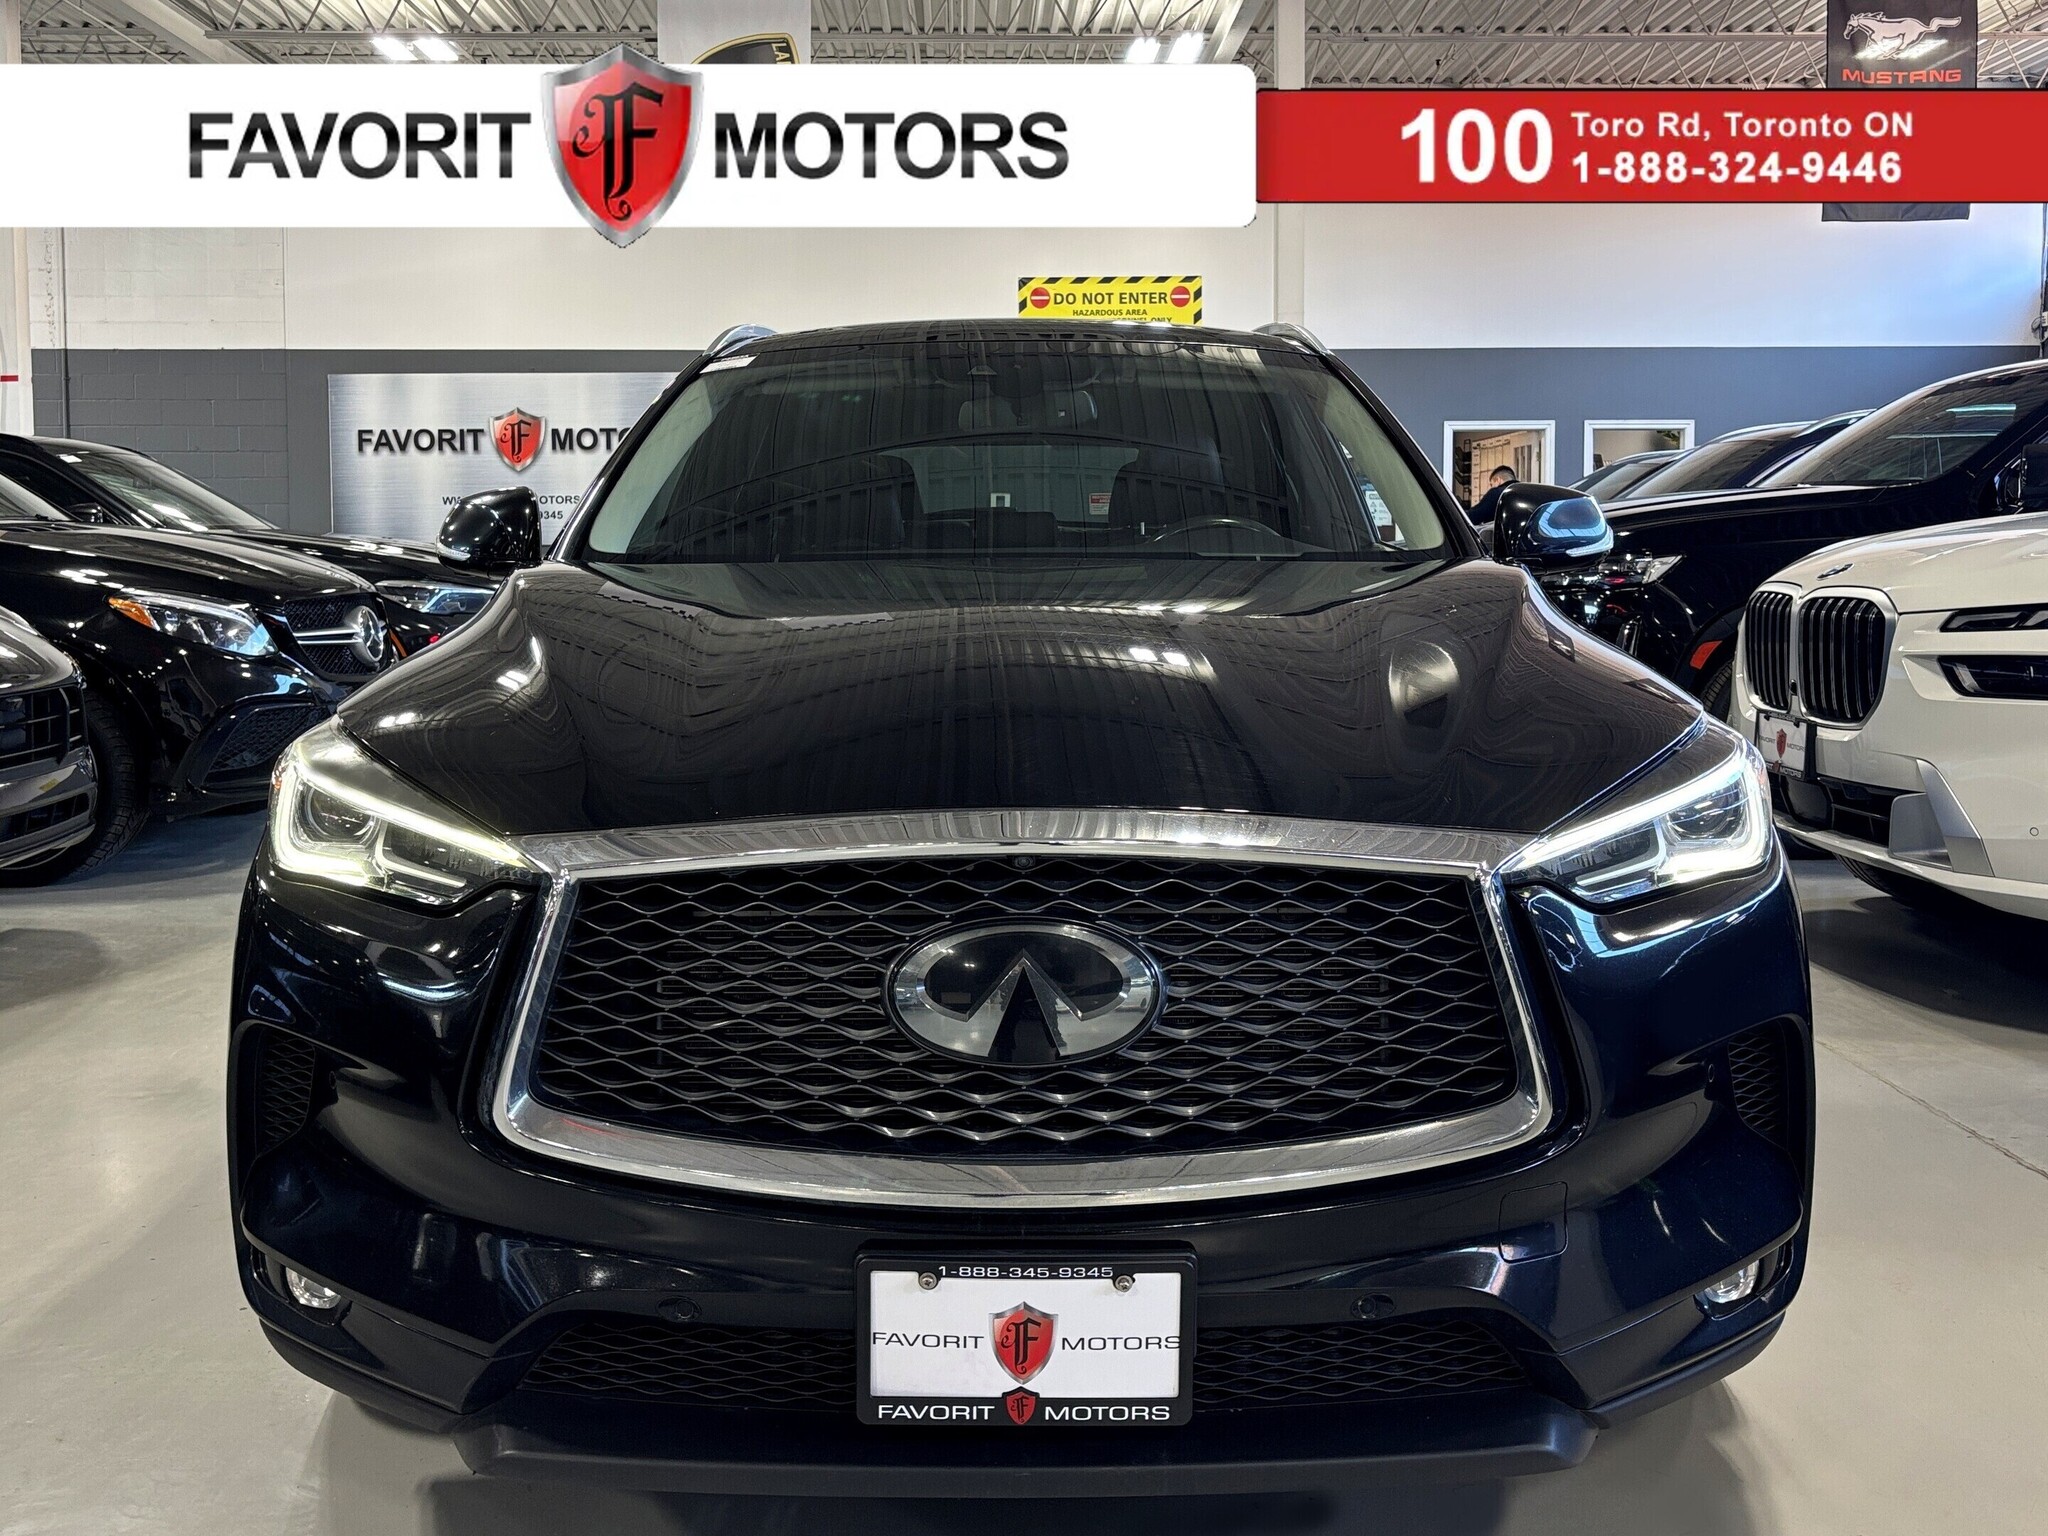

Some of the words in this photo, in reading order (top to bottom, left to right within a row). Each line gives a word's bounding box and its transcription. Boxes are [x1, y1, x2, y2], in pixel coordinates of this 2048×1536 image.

[1842, 67, 1961, 85] MUSTANG
[1053, 293, 1077, 305] DO
[1082, 292, 1114, 305] NOT
[1119, 291, 1168, 304] ENTER
[1072, 309, 1123, 317] HAZARDOUS
[358, 428, 485, 452] FAVORIT
[938, 1266, 1113, 1278] 1-888-345-9345
[872, 1332, 985, 1350] FAVORIT
[1062, 1335, 1181, 1351] MOTORS
[878, 1405, 995, 1421] FAVORIT
[1045, 1405, 1170, 1421] MOTORS
